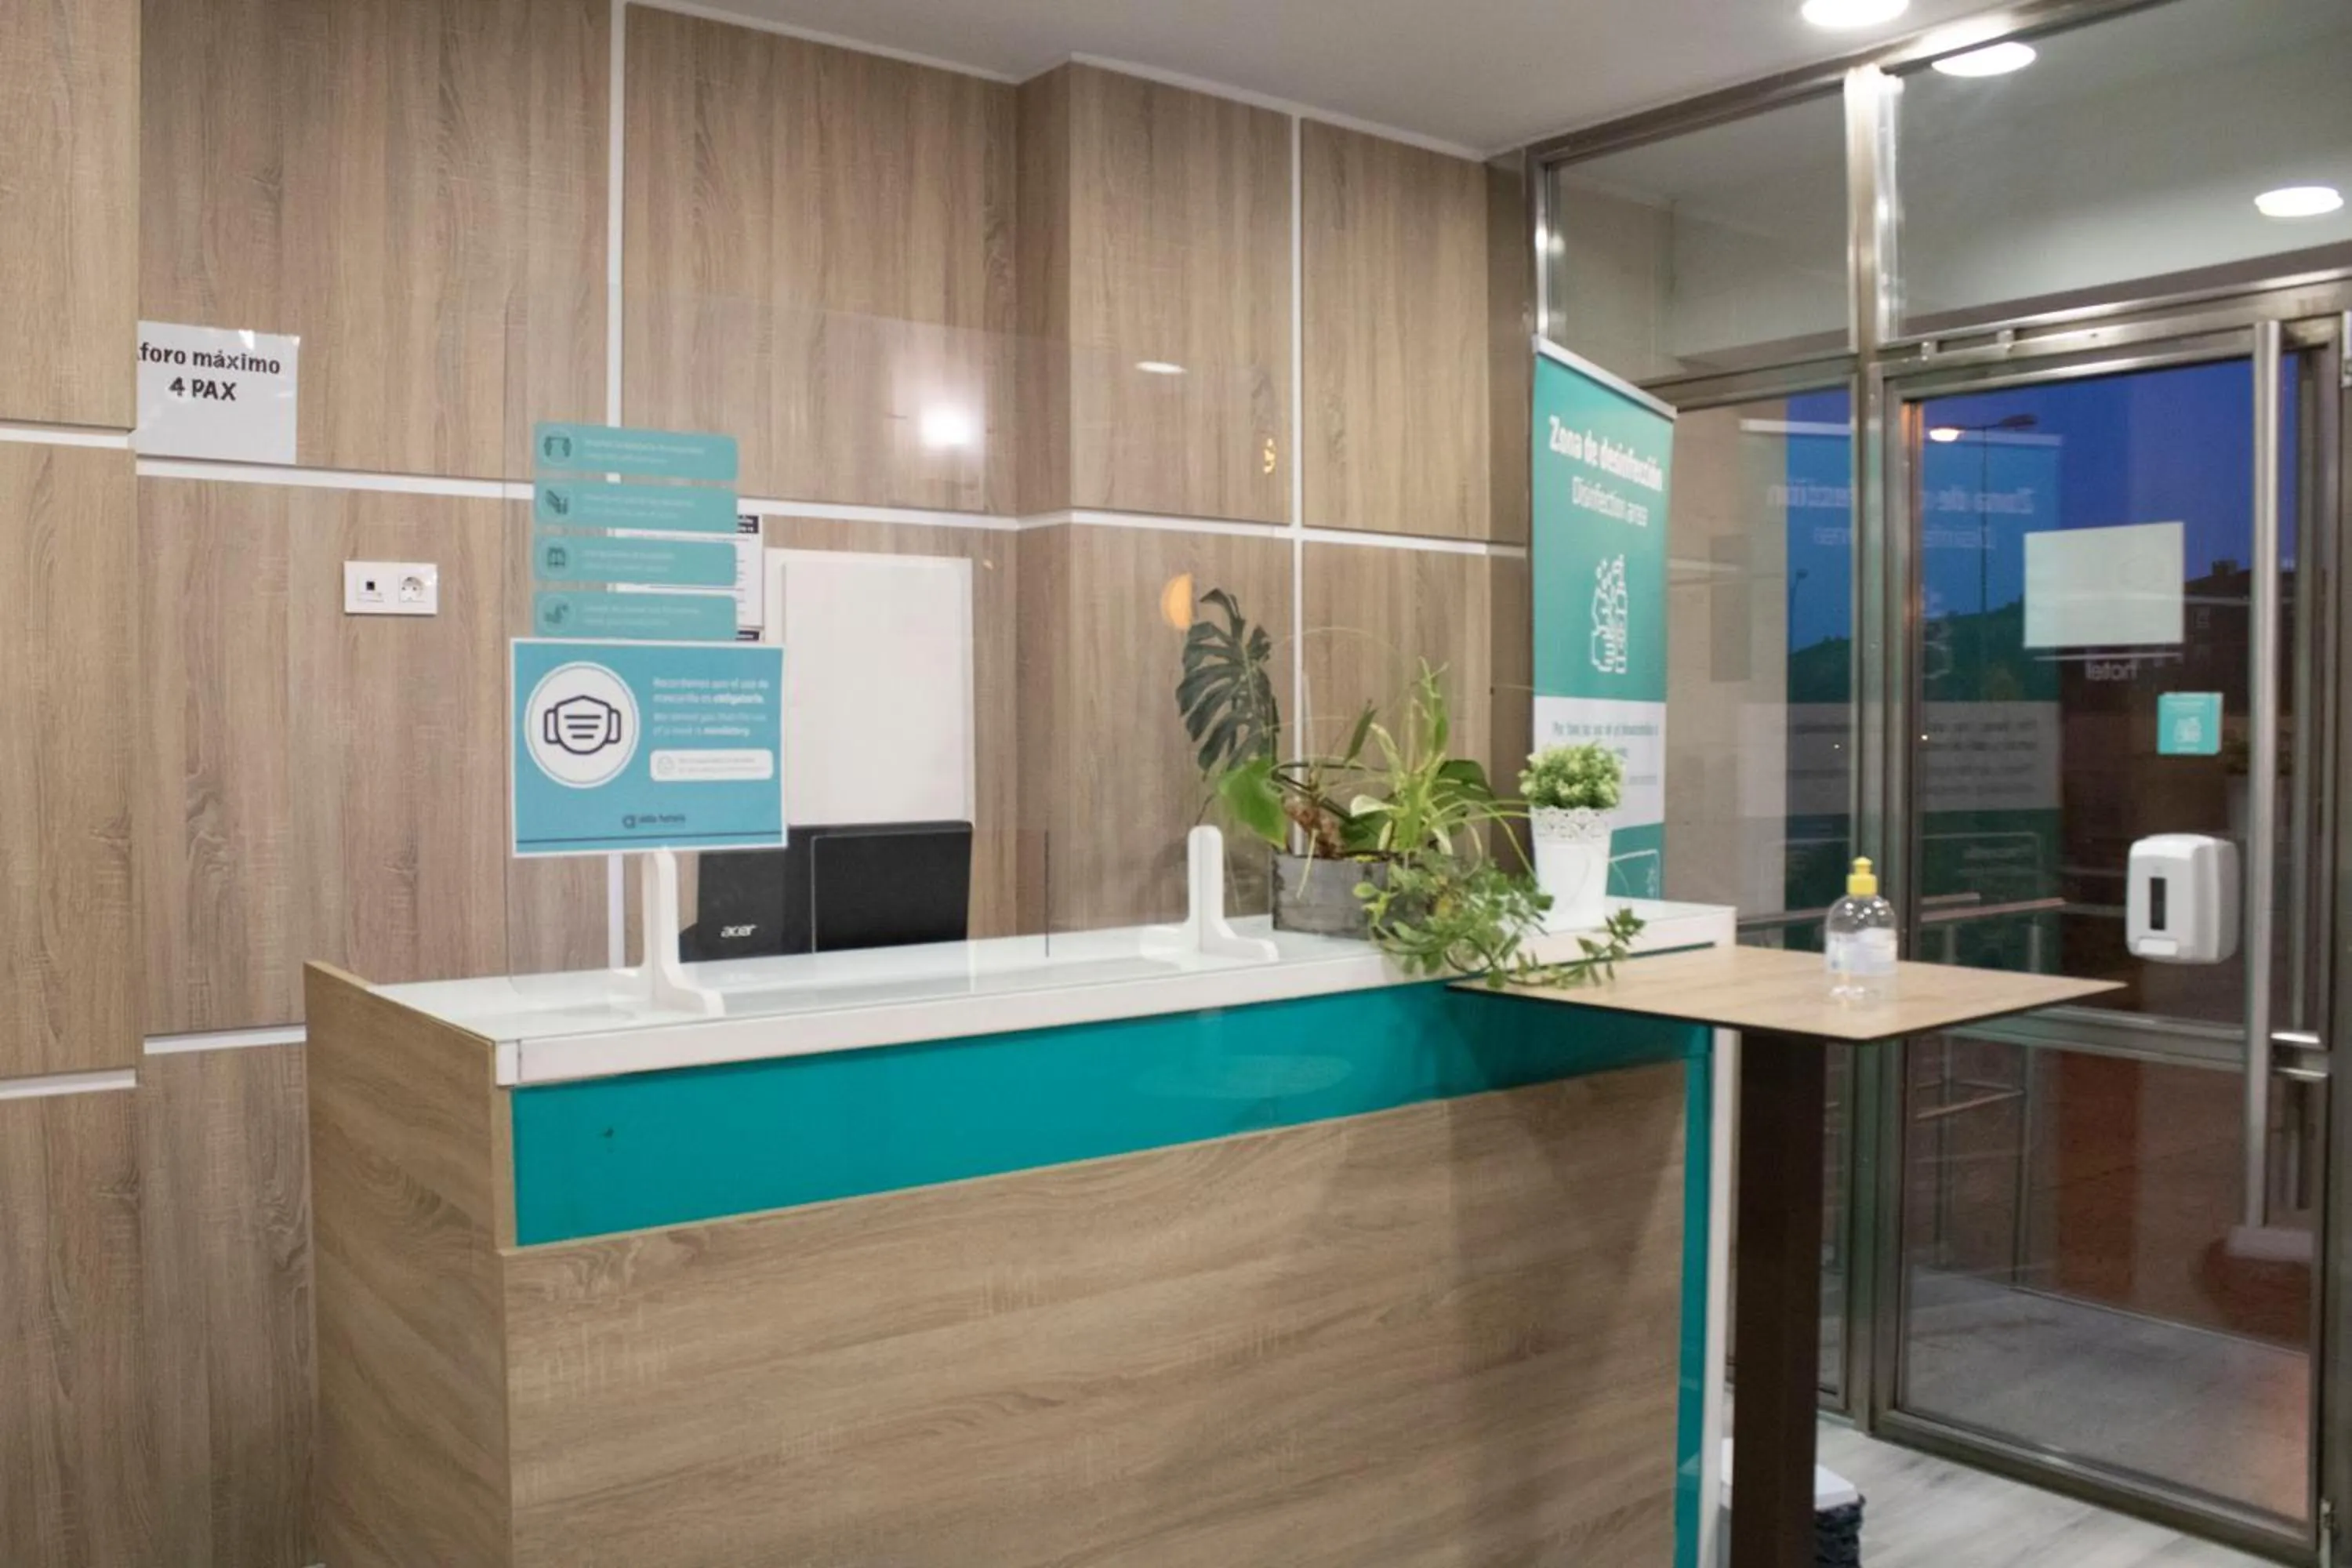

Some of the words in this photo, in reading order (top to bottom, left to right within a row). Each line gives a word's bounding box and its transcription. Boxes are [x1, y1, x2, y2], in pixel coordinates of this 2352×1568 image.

[137, 341, 187, 365] foro
[192, 349, 281, 375] máximo
[168, 376, 186, 397] 4
[191, 379, 238, 401] PAX
[720, 924, 757, 938] acer
